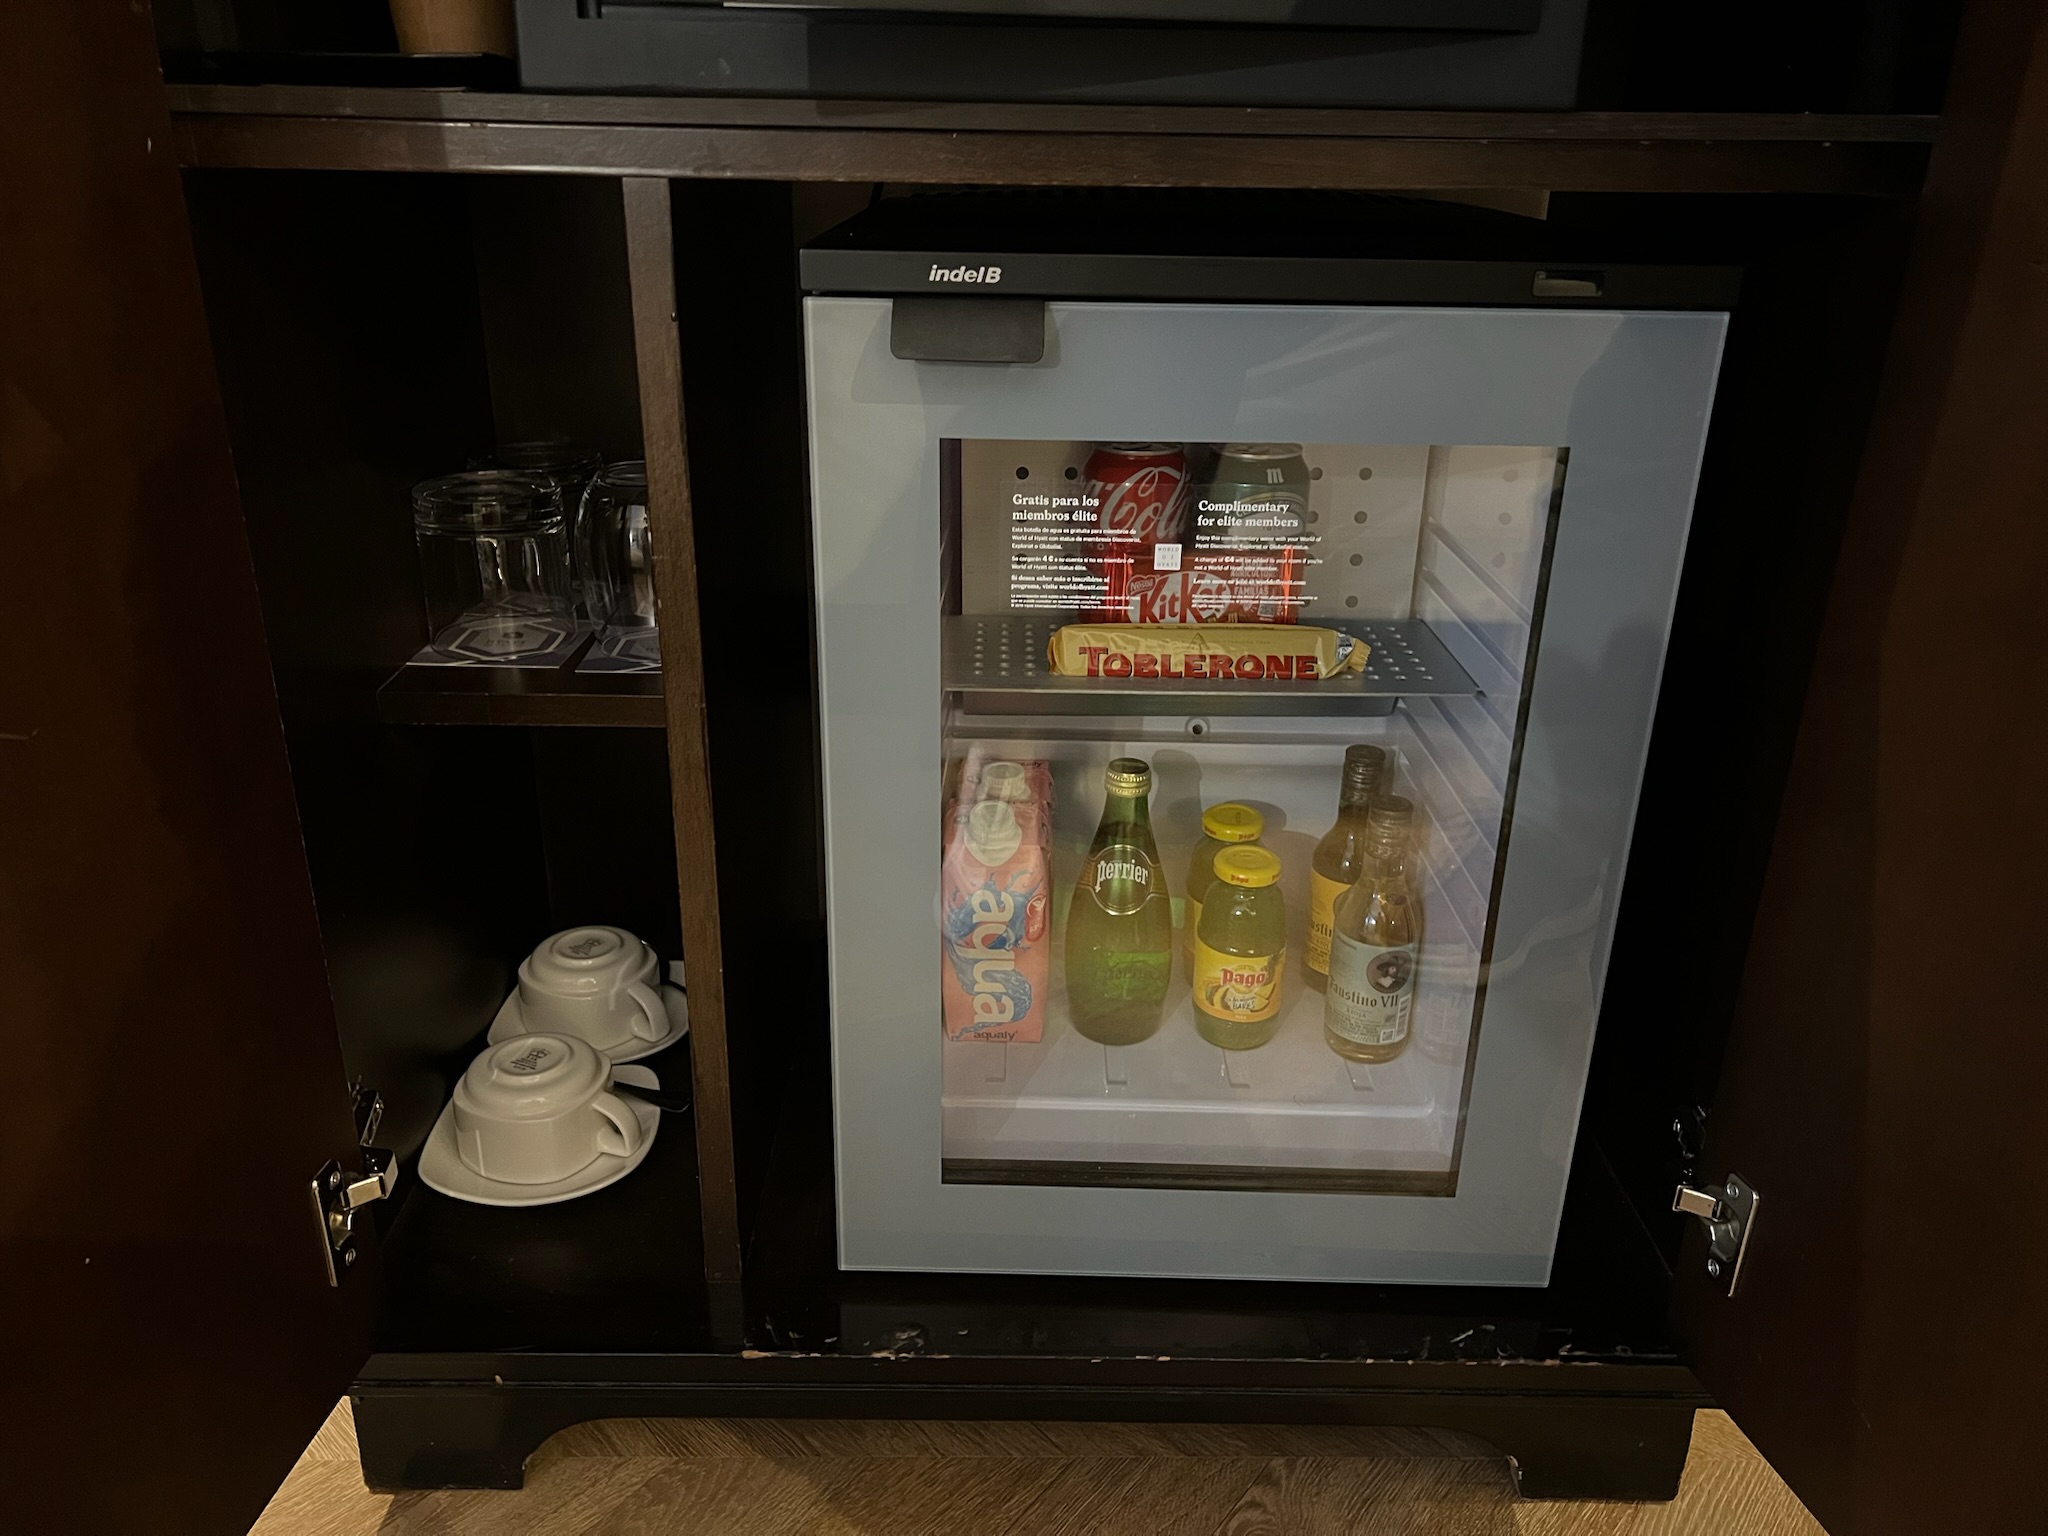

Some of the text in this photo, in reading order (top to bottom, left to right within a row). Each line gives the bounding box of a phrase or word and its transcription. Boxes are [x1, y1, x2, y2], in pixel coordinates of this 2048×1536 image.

[1012, 493, 1099, 507] Gratis para los
[1198, 500, 1289, 514] Complimentary
[1012, 509, 1098, 521] miembros élite
[1197, 515, 1298, 527] for elite members
[1079, 646, 1320, 680] TOBLERONE
[952, 889, 1015, 1024] aqua
[974, 1031, 1015, 1041] aqualy
